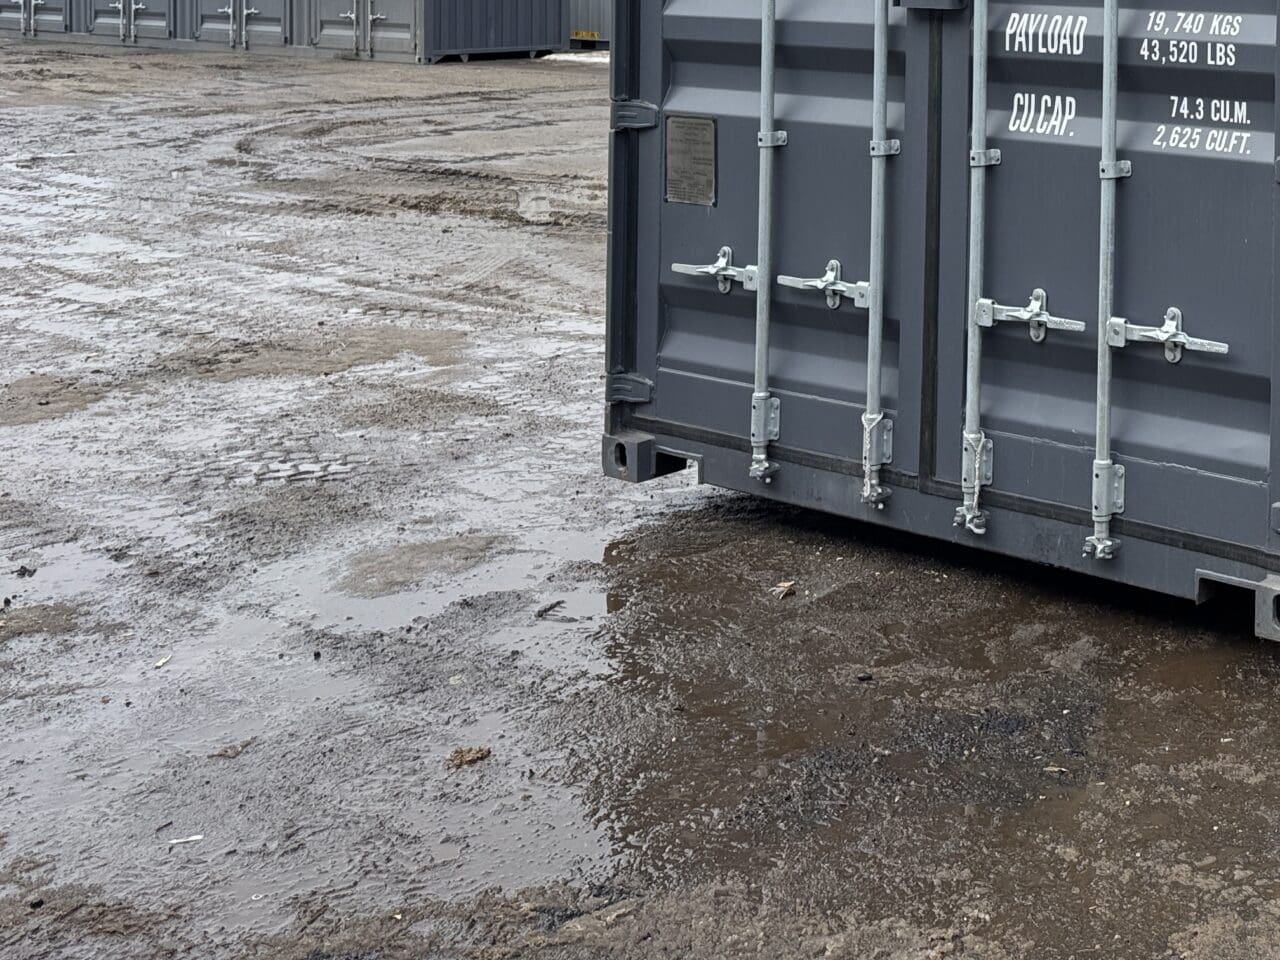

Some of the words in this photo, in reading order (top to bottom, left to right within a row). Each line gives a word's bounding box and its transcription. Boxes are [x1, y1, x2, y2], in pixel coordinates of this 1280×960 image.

[1005, 13, 1087, 55] PAYLOAD
[1147, 11, 1204, 35] 19,740
[1209, 14, 1242, 36] KGS
[1140, 38, 1198, 65] 43,520
[1207, 42, 1236, 66] LBS
[1009, 93, 1074, 136] CU.CAP.
[1170, 96, 1204, 119] 74.3
[1211, 99, 1251, 124] CU.M.
[1153, 125, 1202, 149] 2,625
[1205, 130, 1251, 154] CU.FT.
